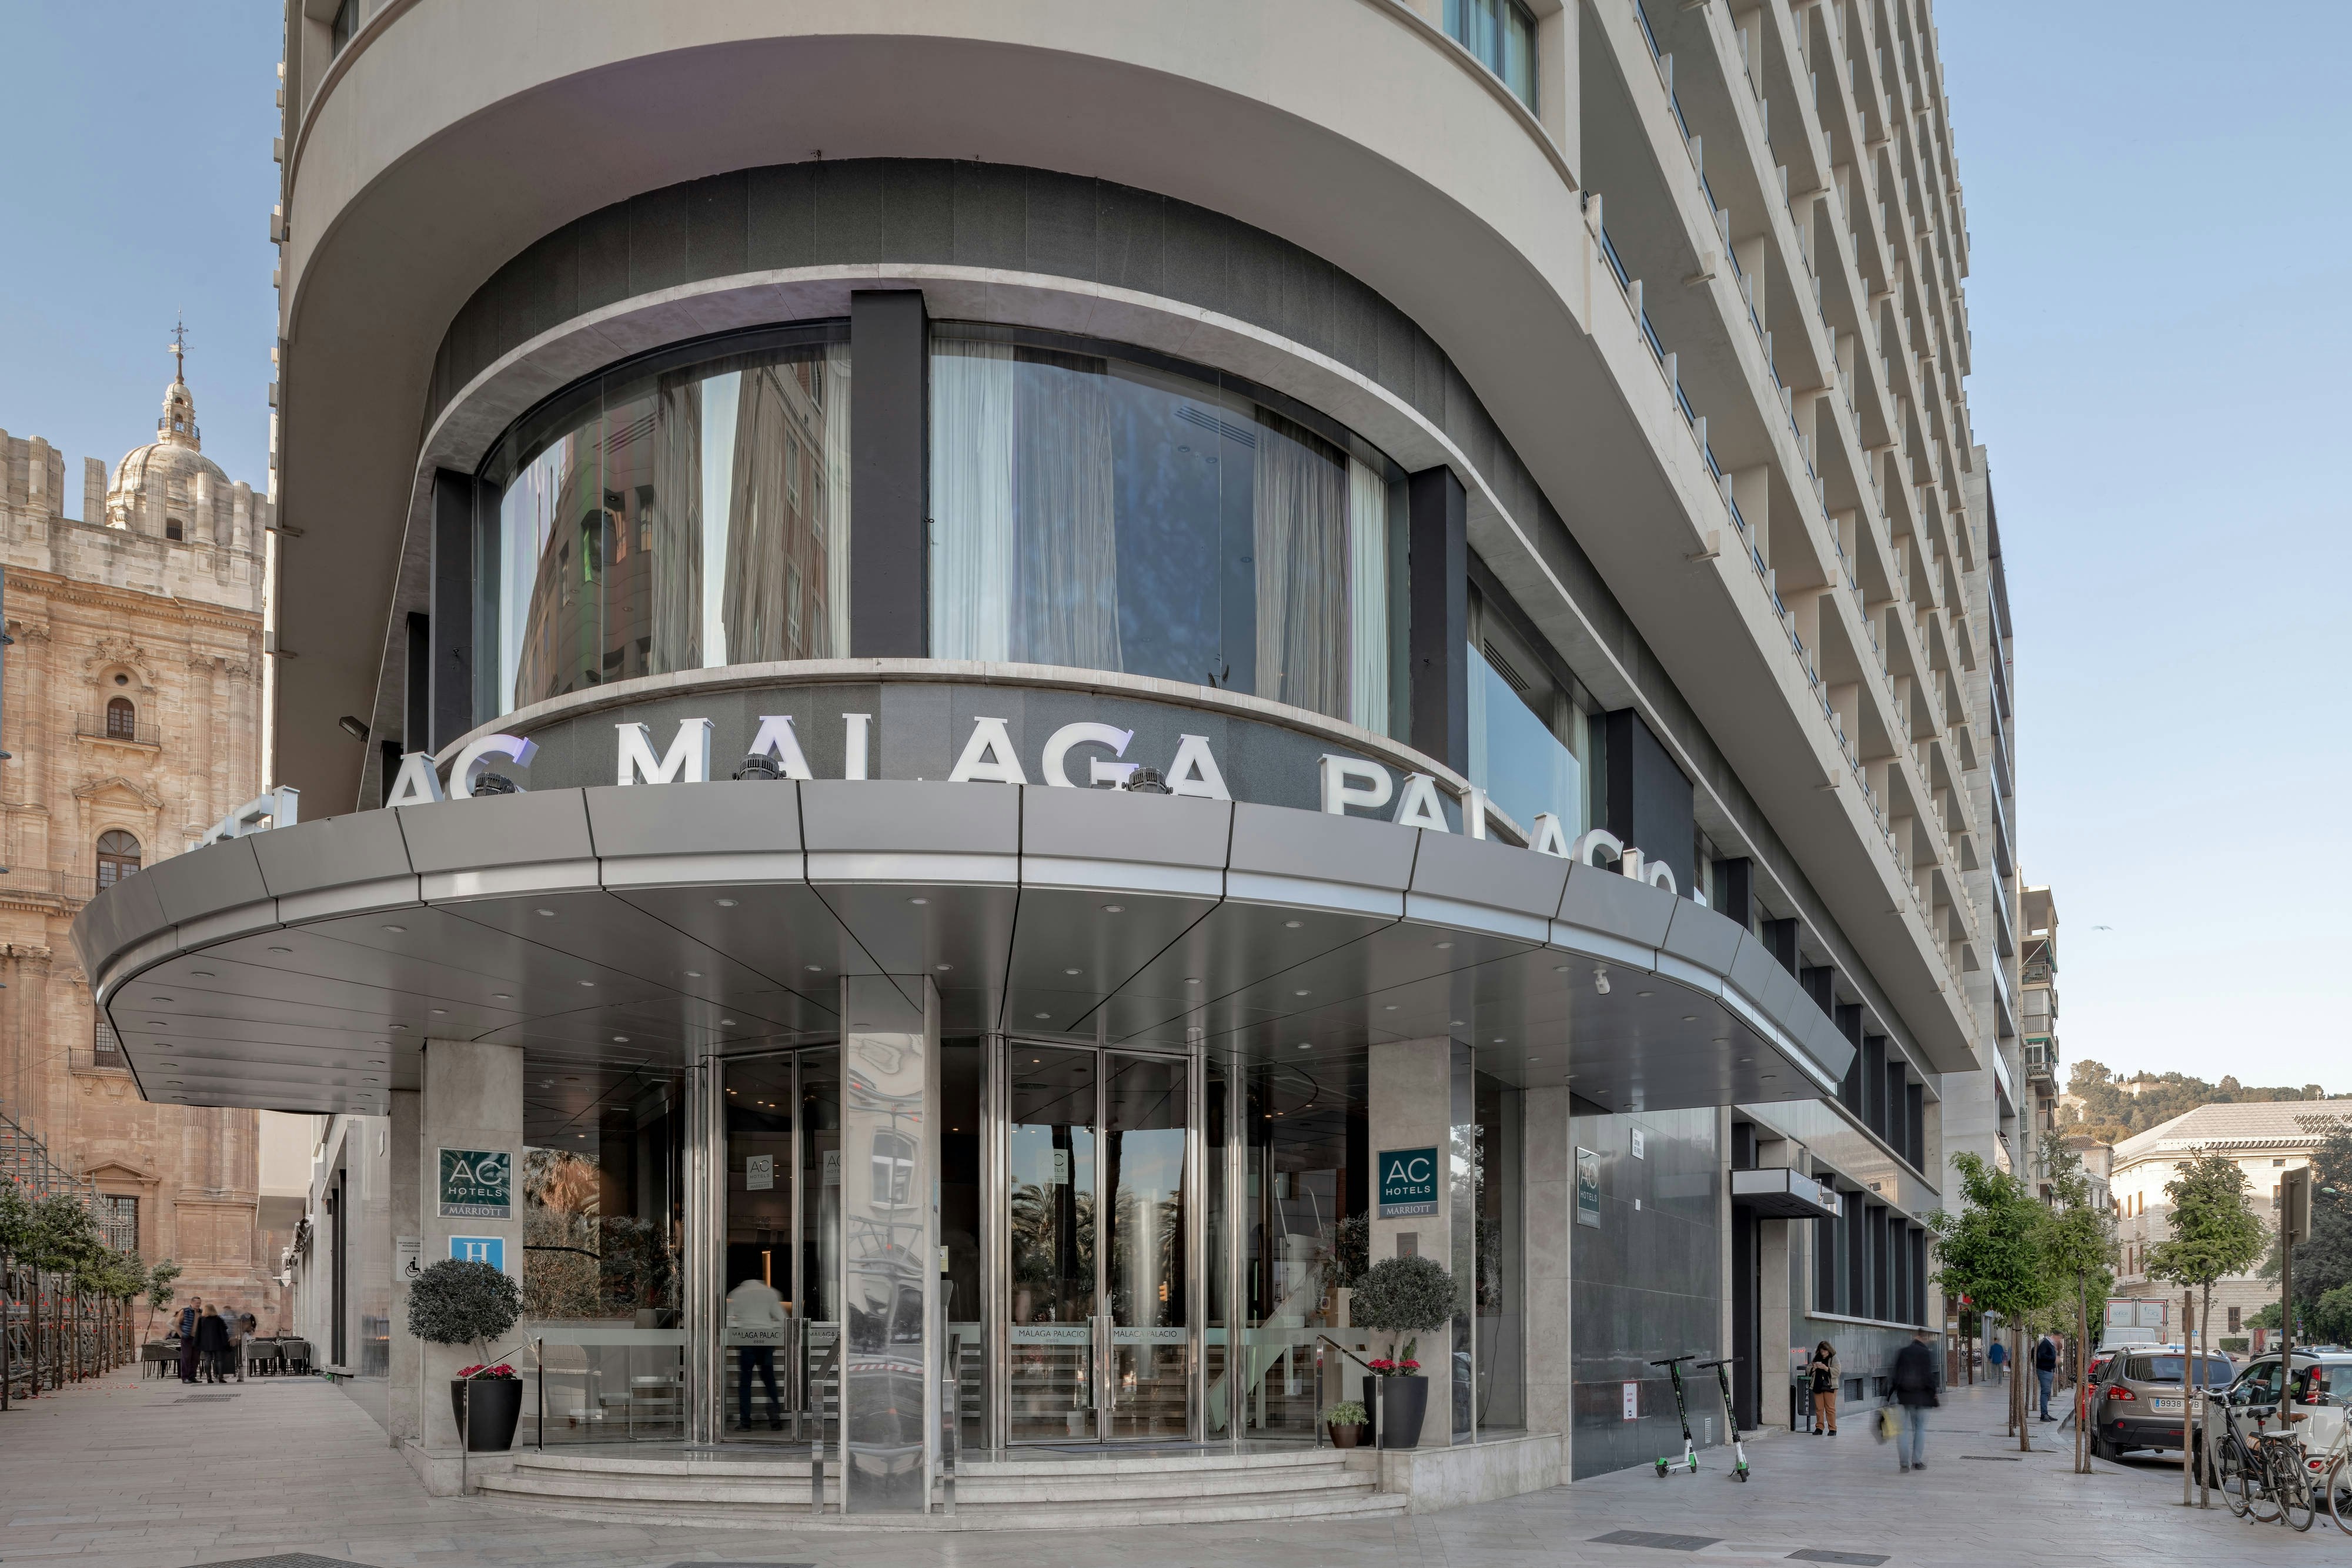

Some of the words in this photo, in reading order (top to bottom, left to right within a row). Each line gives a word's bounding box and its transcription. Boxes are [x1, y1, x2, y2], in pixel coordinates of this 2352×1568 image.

[386, 734, 539, 808] AC
[750, 1159, 770, 1173] AC
[1386, 1158, 1431, 1184] AC
[449, 1159, 502, 1185] AC
[1581, 1161, 1597, 1189] AC
[448, 1187, 502, 1197] HOTELS
[1386, 1185, 1431, 1196] HOTELS
[1580, 1190, 1597, 1202] HOTELS
[449, 1206, 502, 1216] MARRIOTT
[1387, 1205, 1431, 1215] MARRIOTT
[1581, 1213, 1597, 1223] MARRIOTT
[463, 1242, 490, 1264] H
[732, 1330, 758, 1339] MÁLAGA
[1018, 1329, 1051, 1338] MÁLAGA
[1114, 1329, 1144, 1338] MÁLAGA
